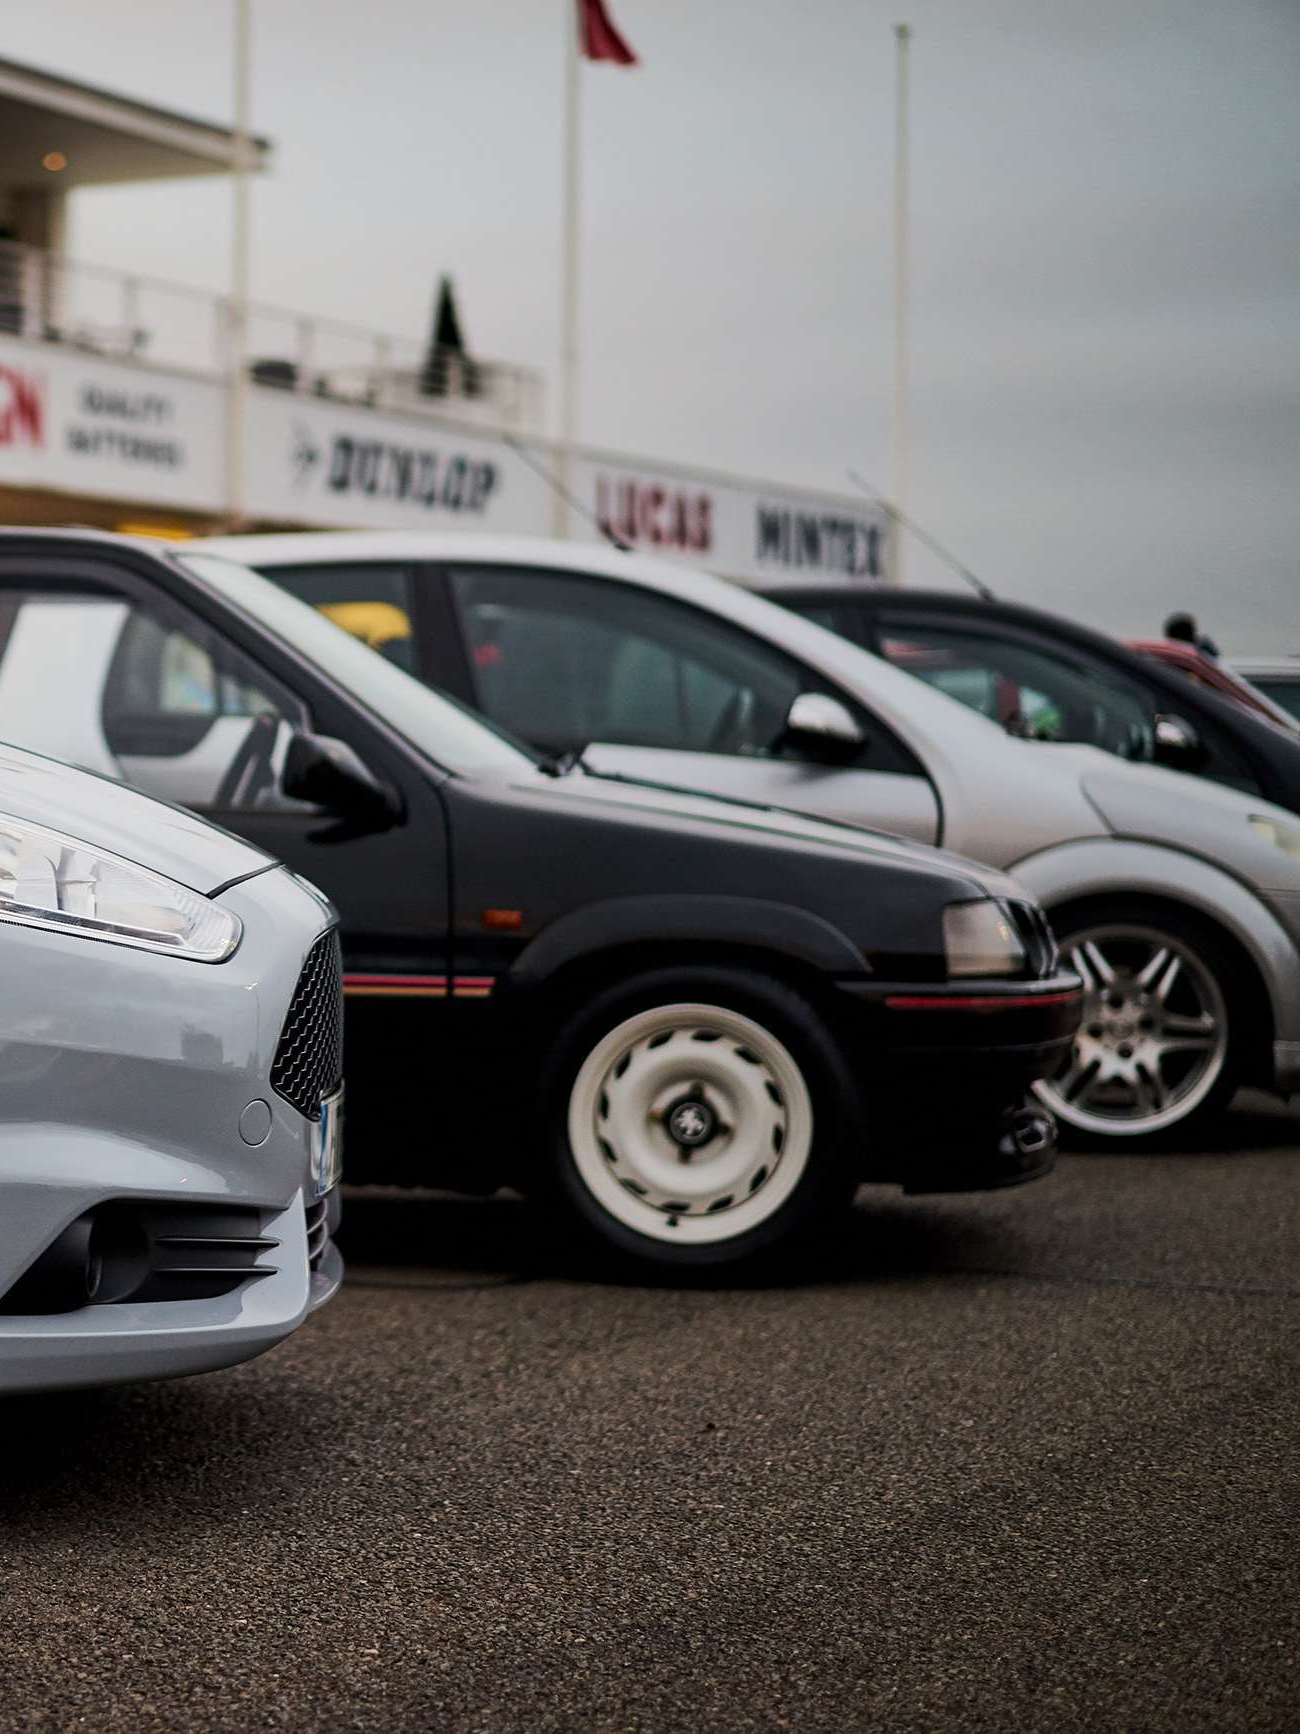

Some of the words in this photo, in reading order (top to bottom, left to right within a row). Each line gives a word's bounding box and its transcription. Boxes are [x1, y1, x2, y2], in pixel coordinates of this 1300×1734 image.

[328, 433, 498, 516] DUNLOP
[596, 472, 712, 552] LUCAS
[756, 503, 883, 577] MINTEX
